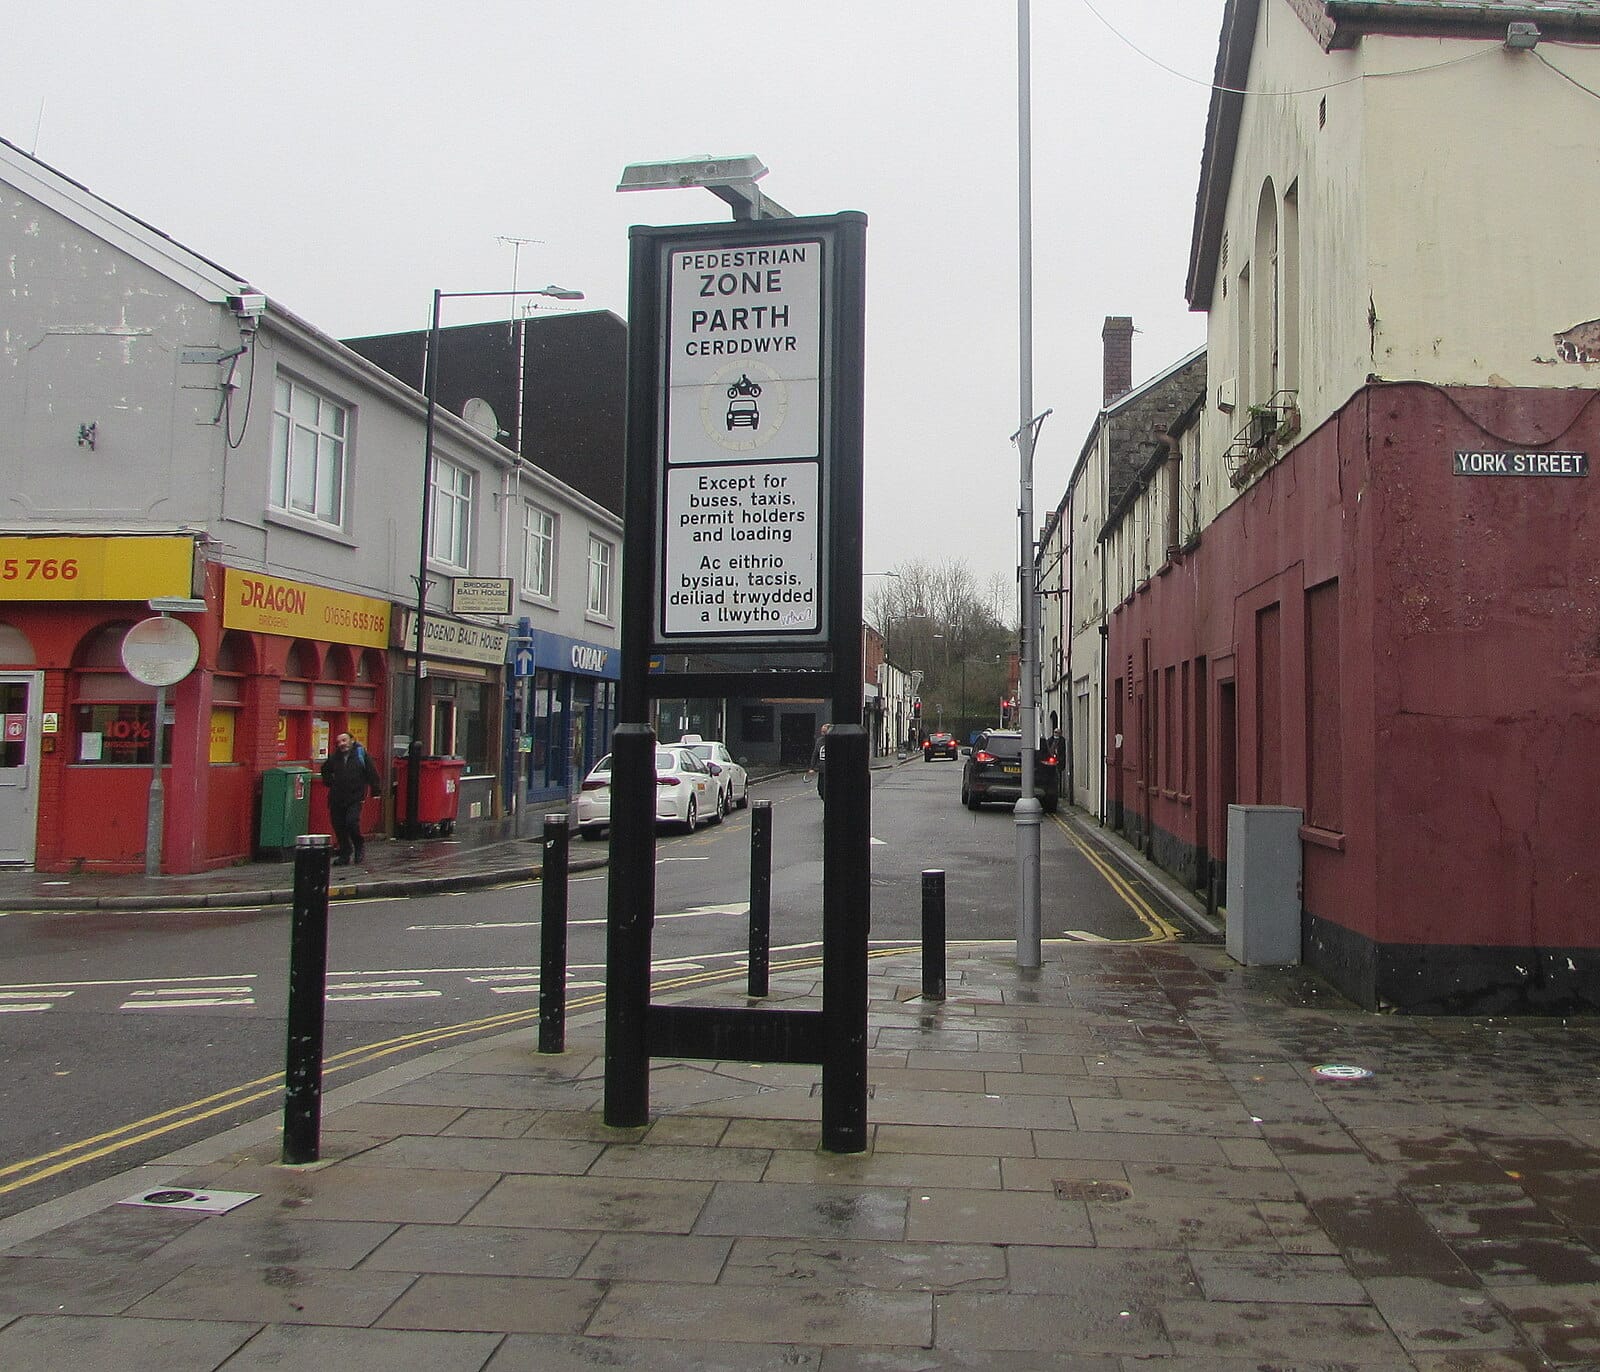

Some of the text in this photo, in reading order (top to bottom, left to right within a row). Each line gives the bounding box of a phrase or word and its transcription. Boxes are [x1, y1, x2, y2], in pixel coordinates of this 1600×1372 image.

[682, 247, 806, 271] PEDESTRIAN
[699, 269, 782, 298] ZONE
[691, 304, 789, 334] PARTH
[685, 336, 798, 356] CERDDWYR
[1459, 453, 1583, 473] YORK STREET
[698, 473, 788, 491] Except for
[689, 491, 796, 508] buses, taxis,
[680, 509, 806, 527] permit holders
[692, 526, 793, 543] and loading
[699, 554, 784, 570] Ac eithrio
[681, 571, 802, 590] bysiau, tacsis,
[240, 579, 307, 616] DRAGON
[481, 589, 508, 597] HOUSE
[670, 588, 814, 606] deiliad trwydded
[352, 611, 385, 633] 655766
[700, 613, 710, 623] a
[718, 606, 781, 625] llwytho
[413, 618, 456, 642] BIDGEND
[457, 627, 479, 646] BALTI
[480, 633, 503, 651] HOUSE
